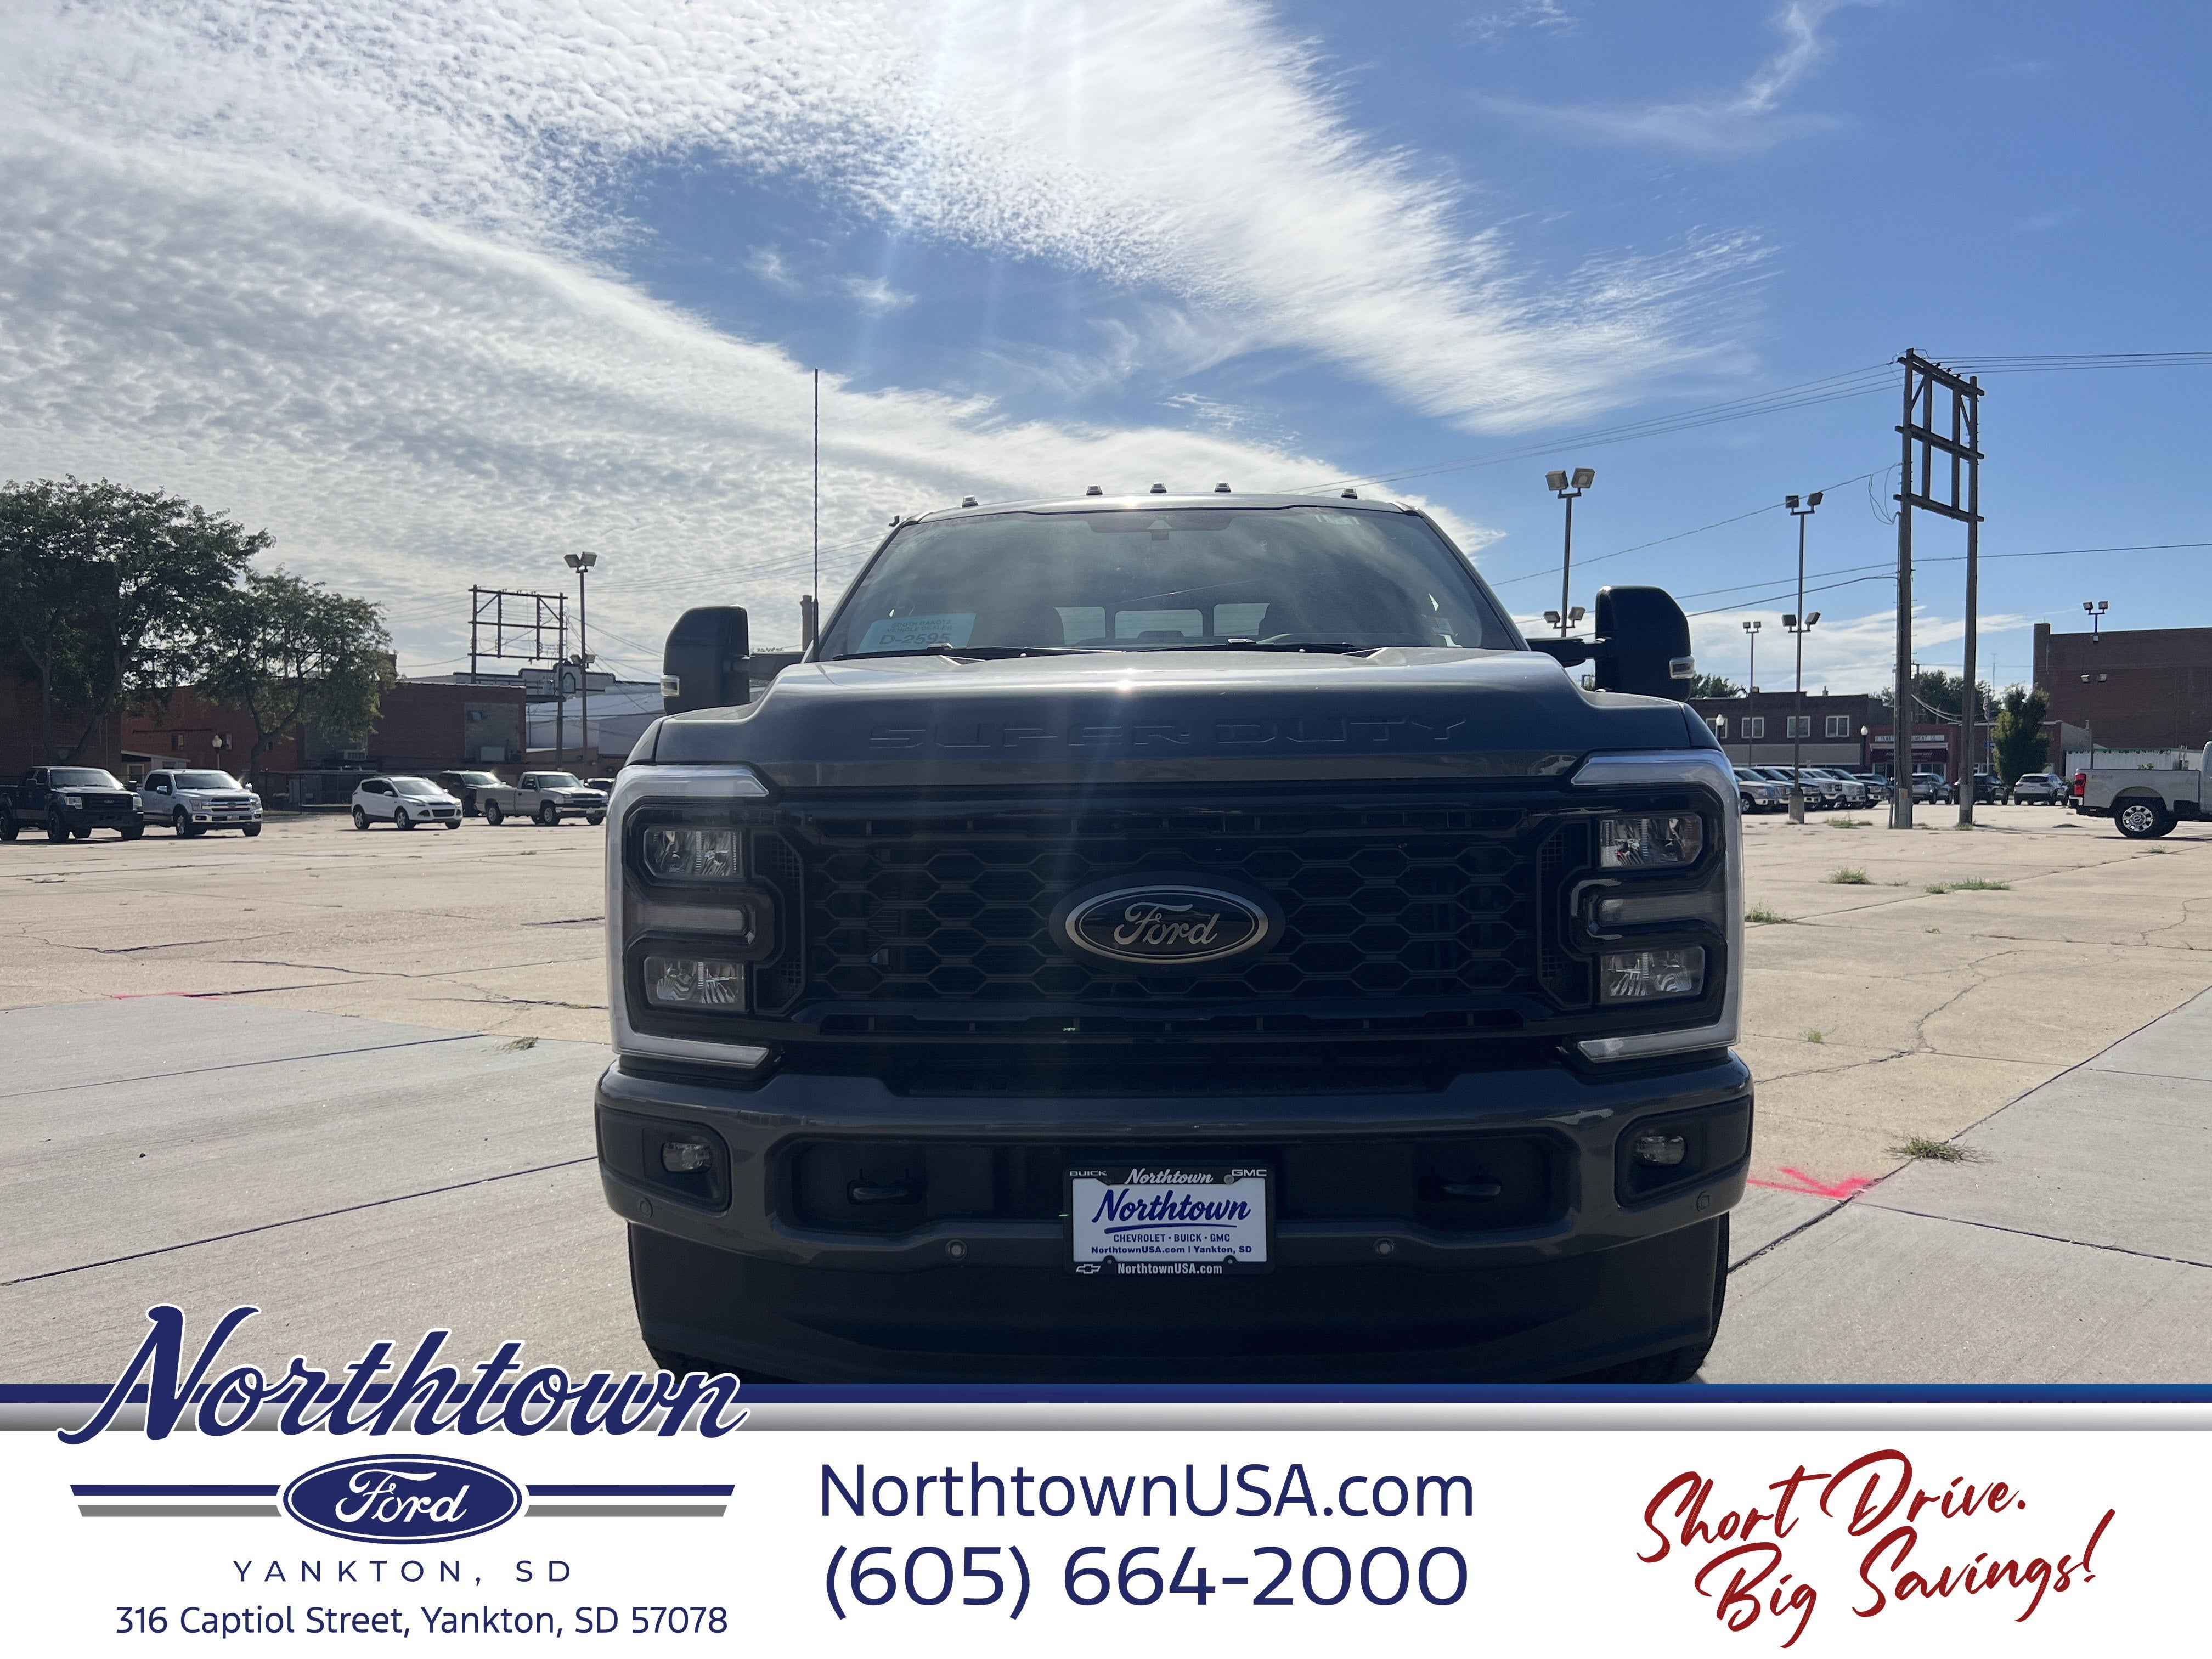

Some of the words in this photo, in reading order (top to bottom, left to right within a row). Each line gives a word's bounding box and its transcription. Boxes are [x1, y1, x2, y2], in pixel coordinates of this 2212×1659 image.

[879, 632, 951, 645] D-2595
[869, 720, 1190, 748] SUPER
[1214, 720, 1466, 743] DUTY
[1114, 902, 1220, 945] Ford
[1124, 1167, 1214, 1184] Northtown
[1091, 1188, 1251, 1223] Northtown
[1113, 1234, 1166, 1243] CHEVROLET
[1173, 1234, 1202, 1242] BUICK
[1210, 1234, 1231, 1242] GMC
[1091, 1246, 1185, 1254] NorthtownUSA.com
[1193, 1245, 1236, 1254] Yankton,
[1118, 1263, 1223, 1274] NorthtownUSA.com
